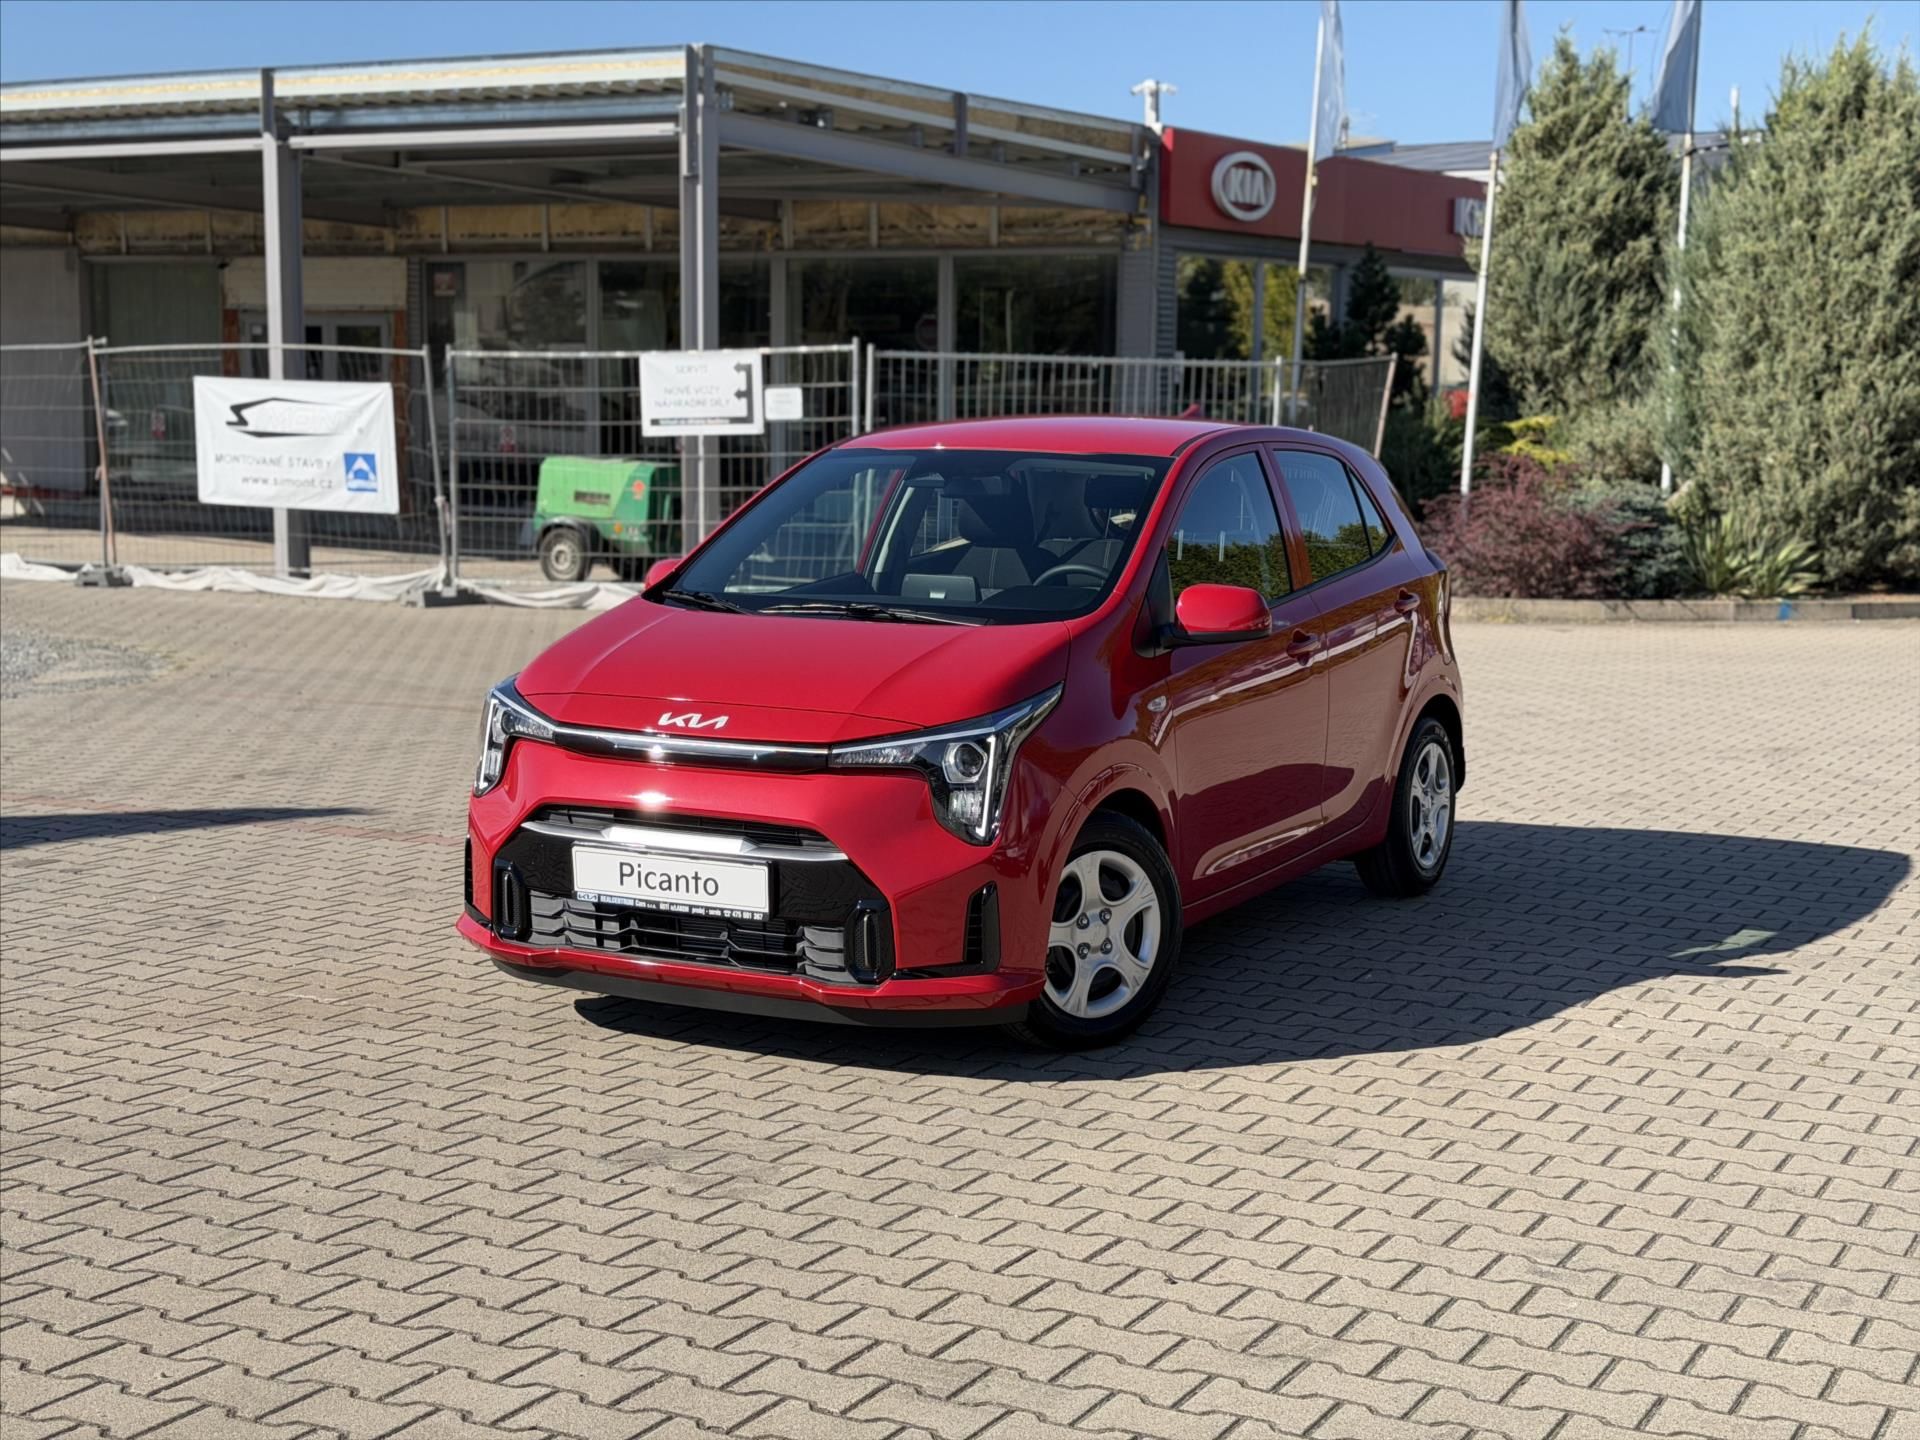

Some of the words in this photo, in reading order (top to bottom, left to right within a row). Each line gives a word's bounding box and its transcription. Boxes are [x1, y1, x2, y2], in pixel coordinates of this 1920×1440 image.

[288, 455, 332, 470] STAVBY
[658, 712, 729, 729] KIA
[619, 861, 719, 897] Picanto
